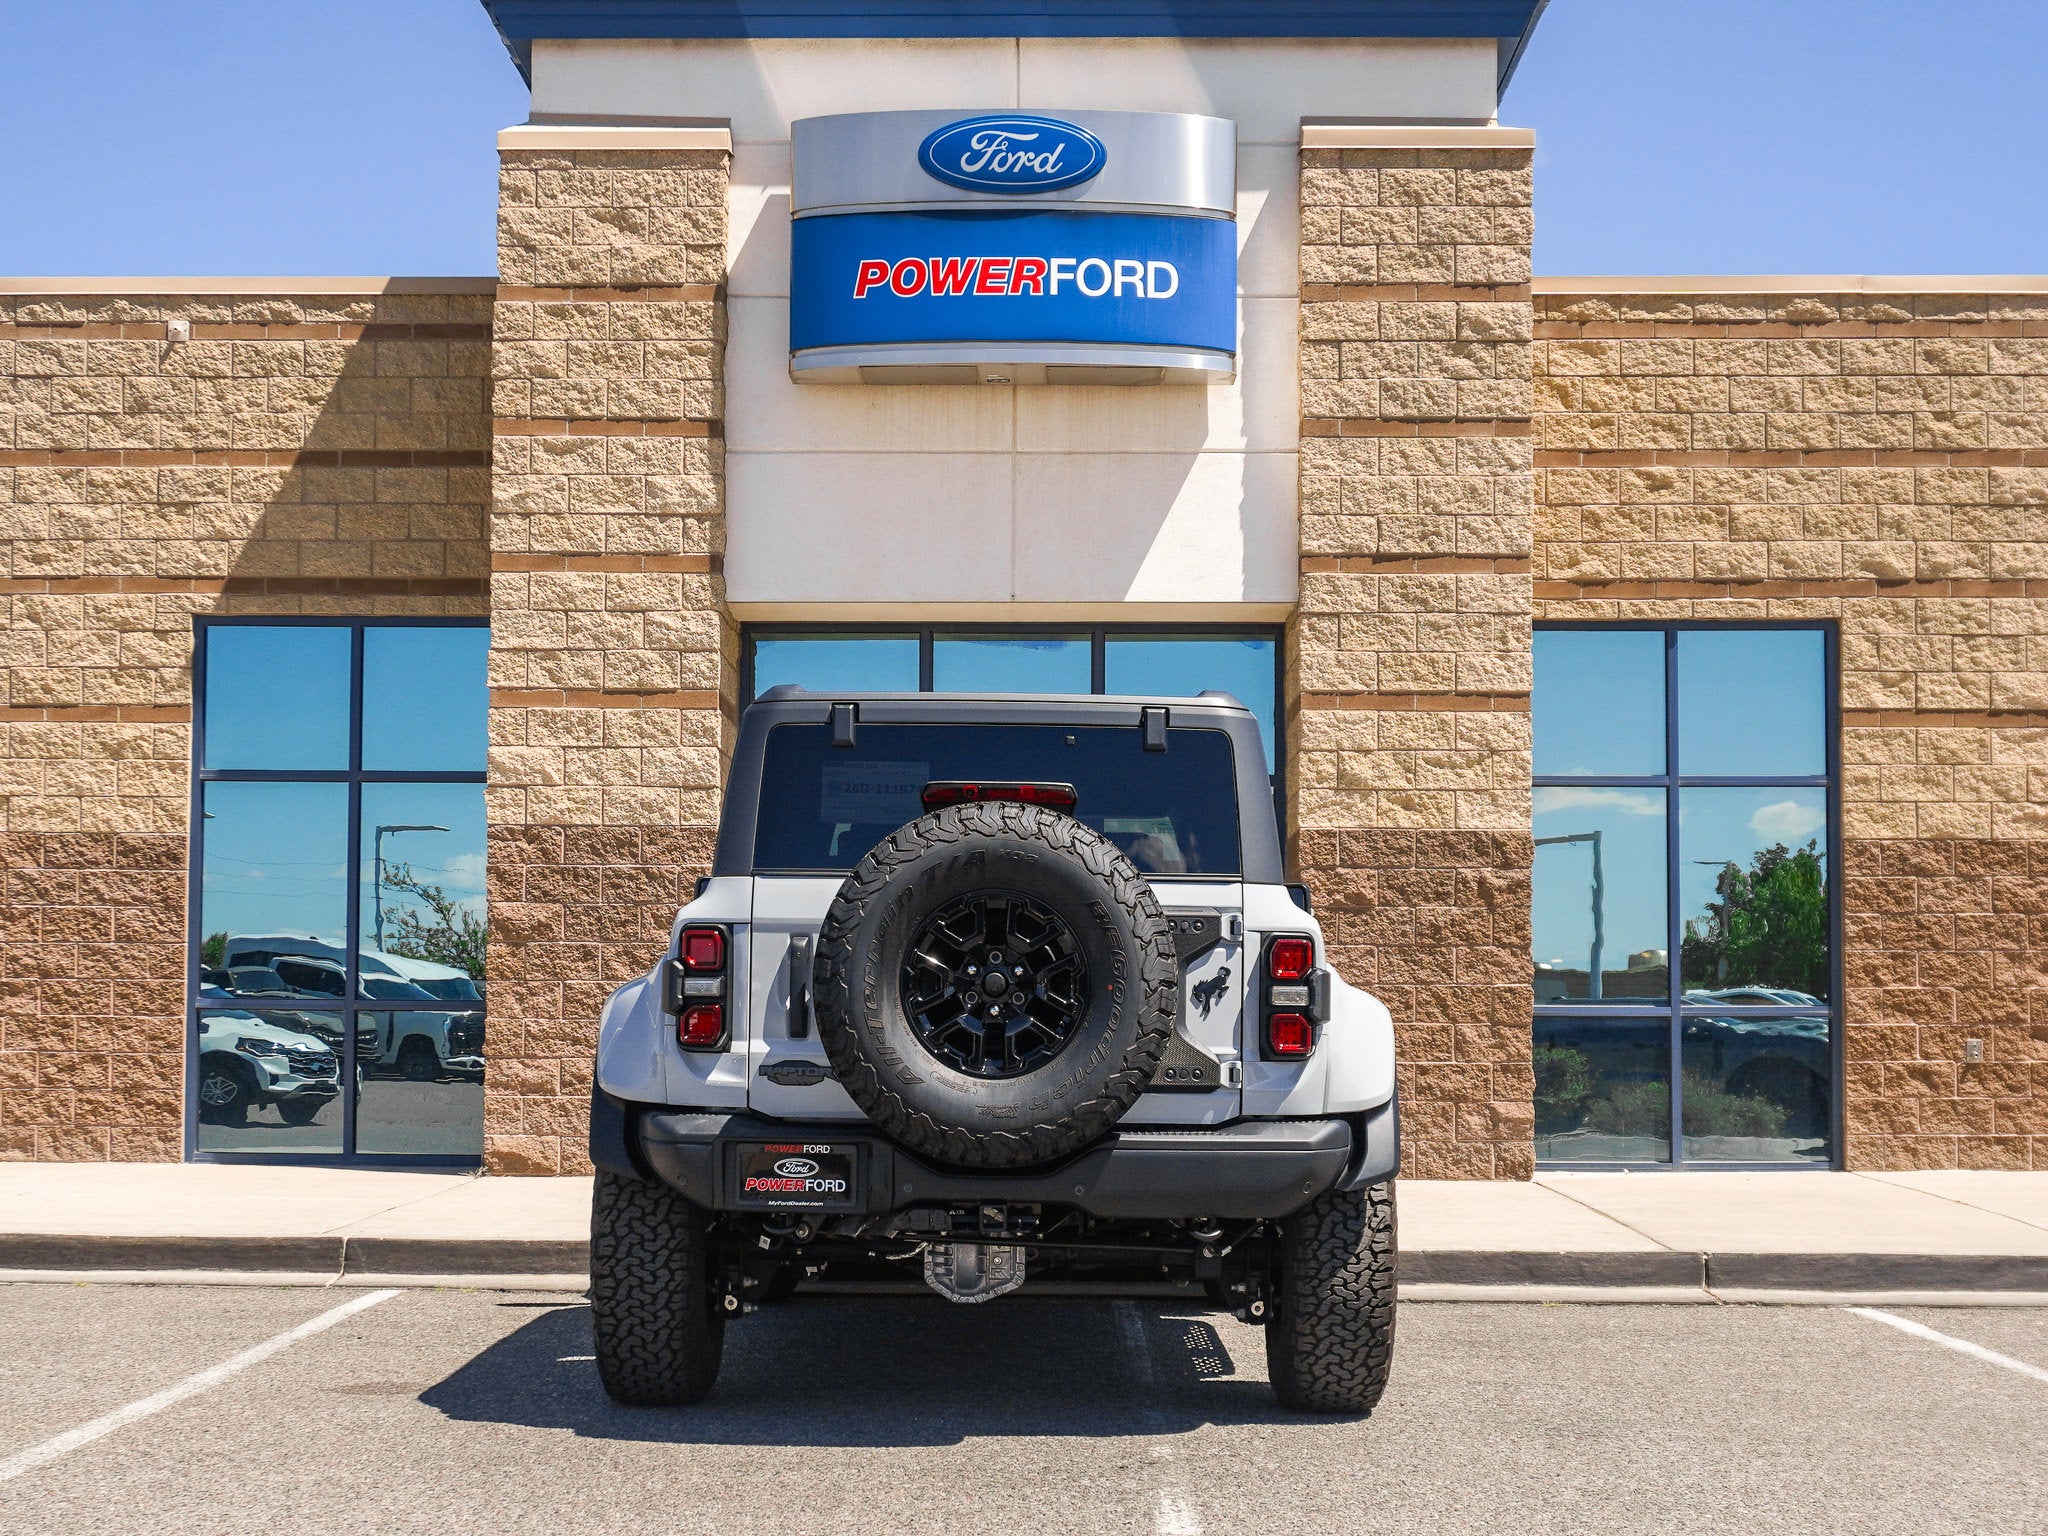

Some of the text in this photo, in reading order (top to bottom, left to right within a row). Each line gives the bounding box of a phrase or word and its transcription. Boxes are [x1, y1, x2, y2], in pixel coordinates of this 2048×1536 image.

[960, 130, 1066, 174] Ford
[852, 256, 1179, 300] POWERFORD
[764, 1144, 831, 1154] POWERFORD
[782, 1161, 810, 1174] Ford
[745, 1178, 846, 1193] POWERFORD
